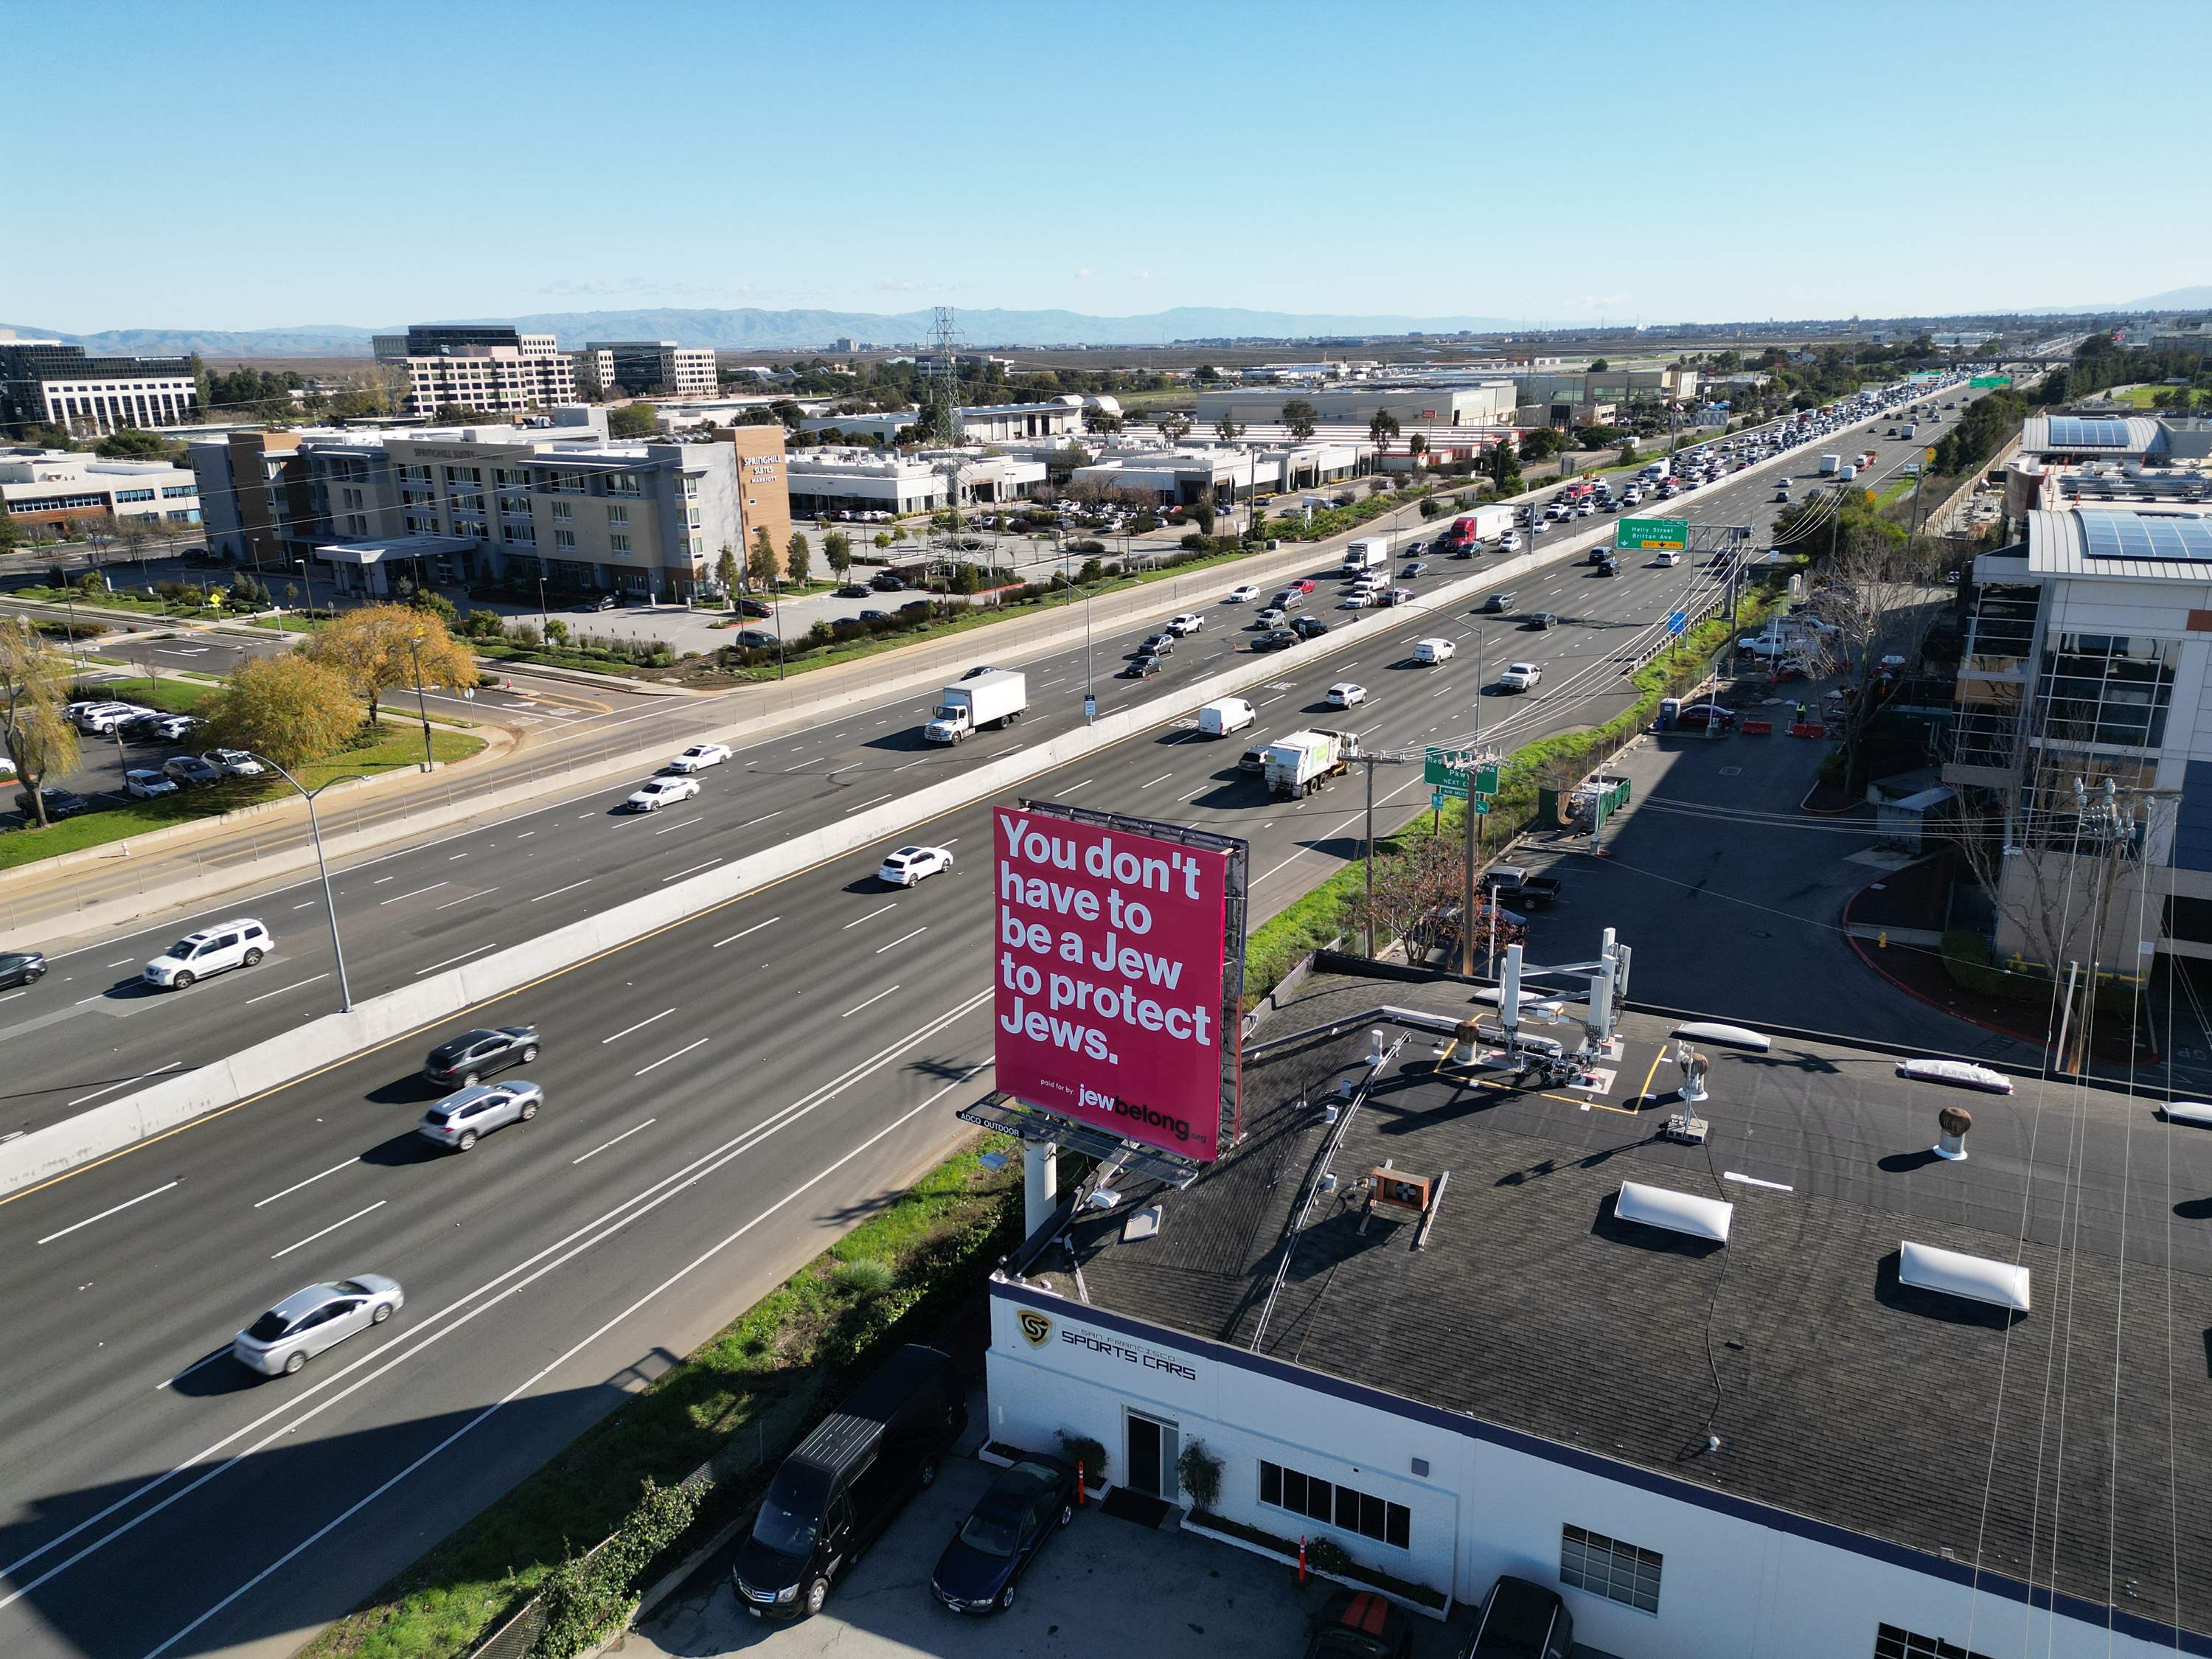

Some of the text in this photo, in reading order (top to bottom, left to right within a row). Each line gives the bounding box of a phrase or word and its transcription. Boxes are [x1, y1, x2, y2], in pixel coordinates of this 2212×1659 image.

[744, 454, 782, 466] SPRINGHILL
[754, 466, 773, 474] SUITES
[1000, 814, 1200, 900] You don't
[1001, 860, 1152, 934] have to
[1001, 905, 1183, 990] be a Jew
[1001, 952, 1211, 1046] to protect
[1000, 998, 1119, 1065] Jews.
[1040, 1079, 1054, 1088] paid
[1056, 1082, 1065, 1091] for
[1065, 1086, 1074, 1096] by
[961, 1113, 1020, 1137] ADCO OUTDOOR
[1062, 1330, 1196, 1380] SPORTS CARS
[1080, 1329, 1175, 1362] SAN FRANCISCO
